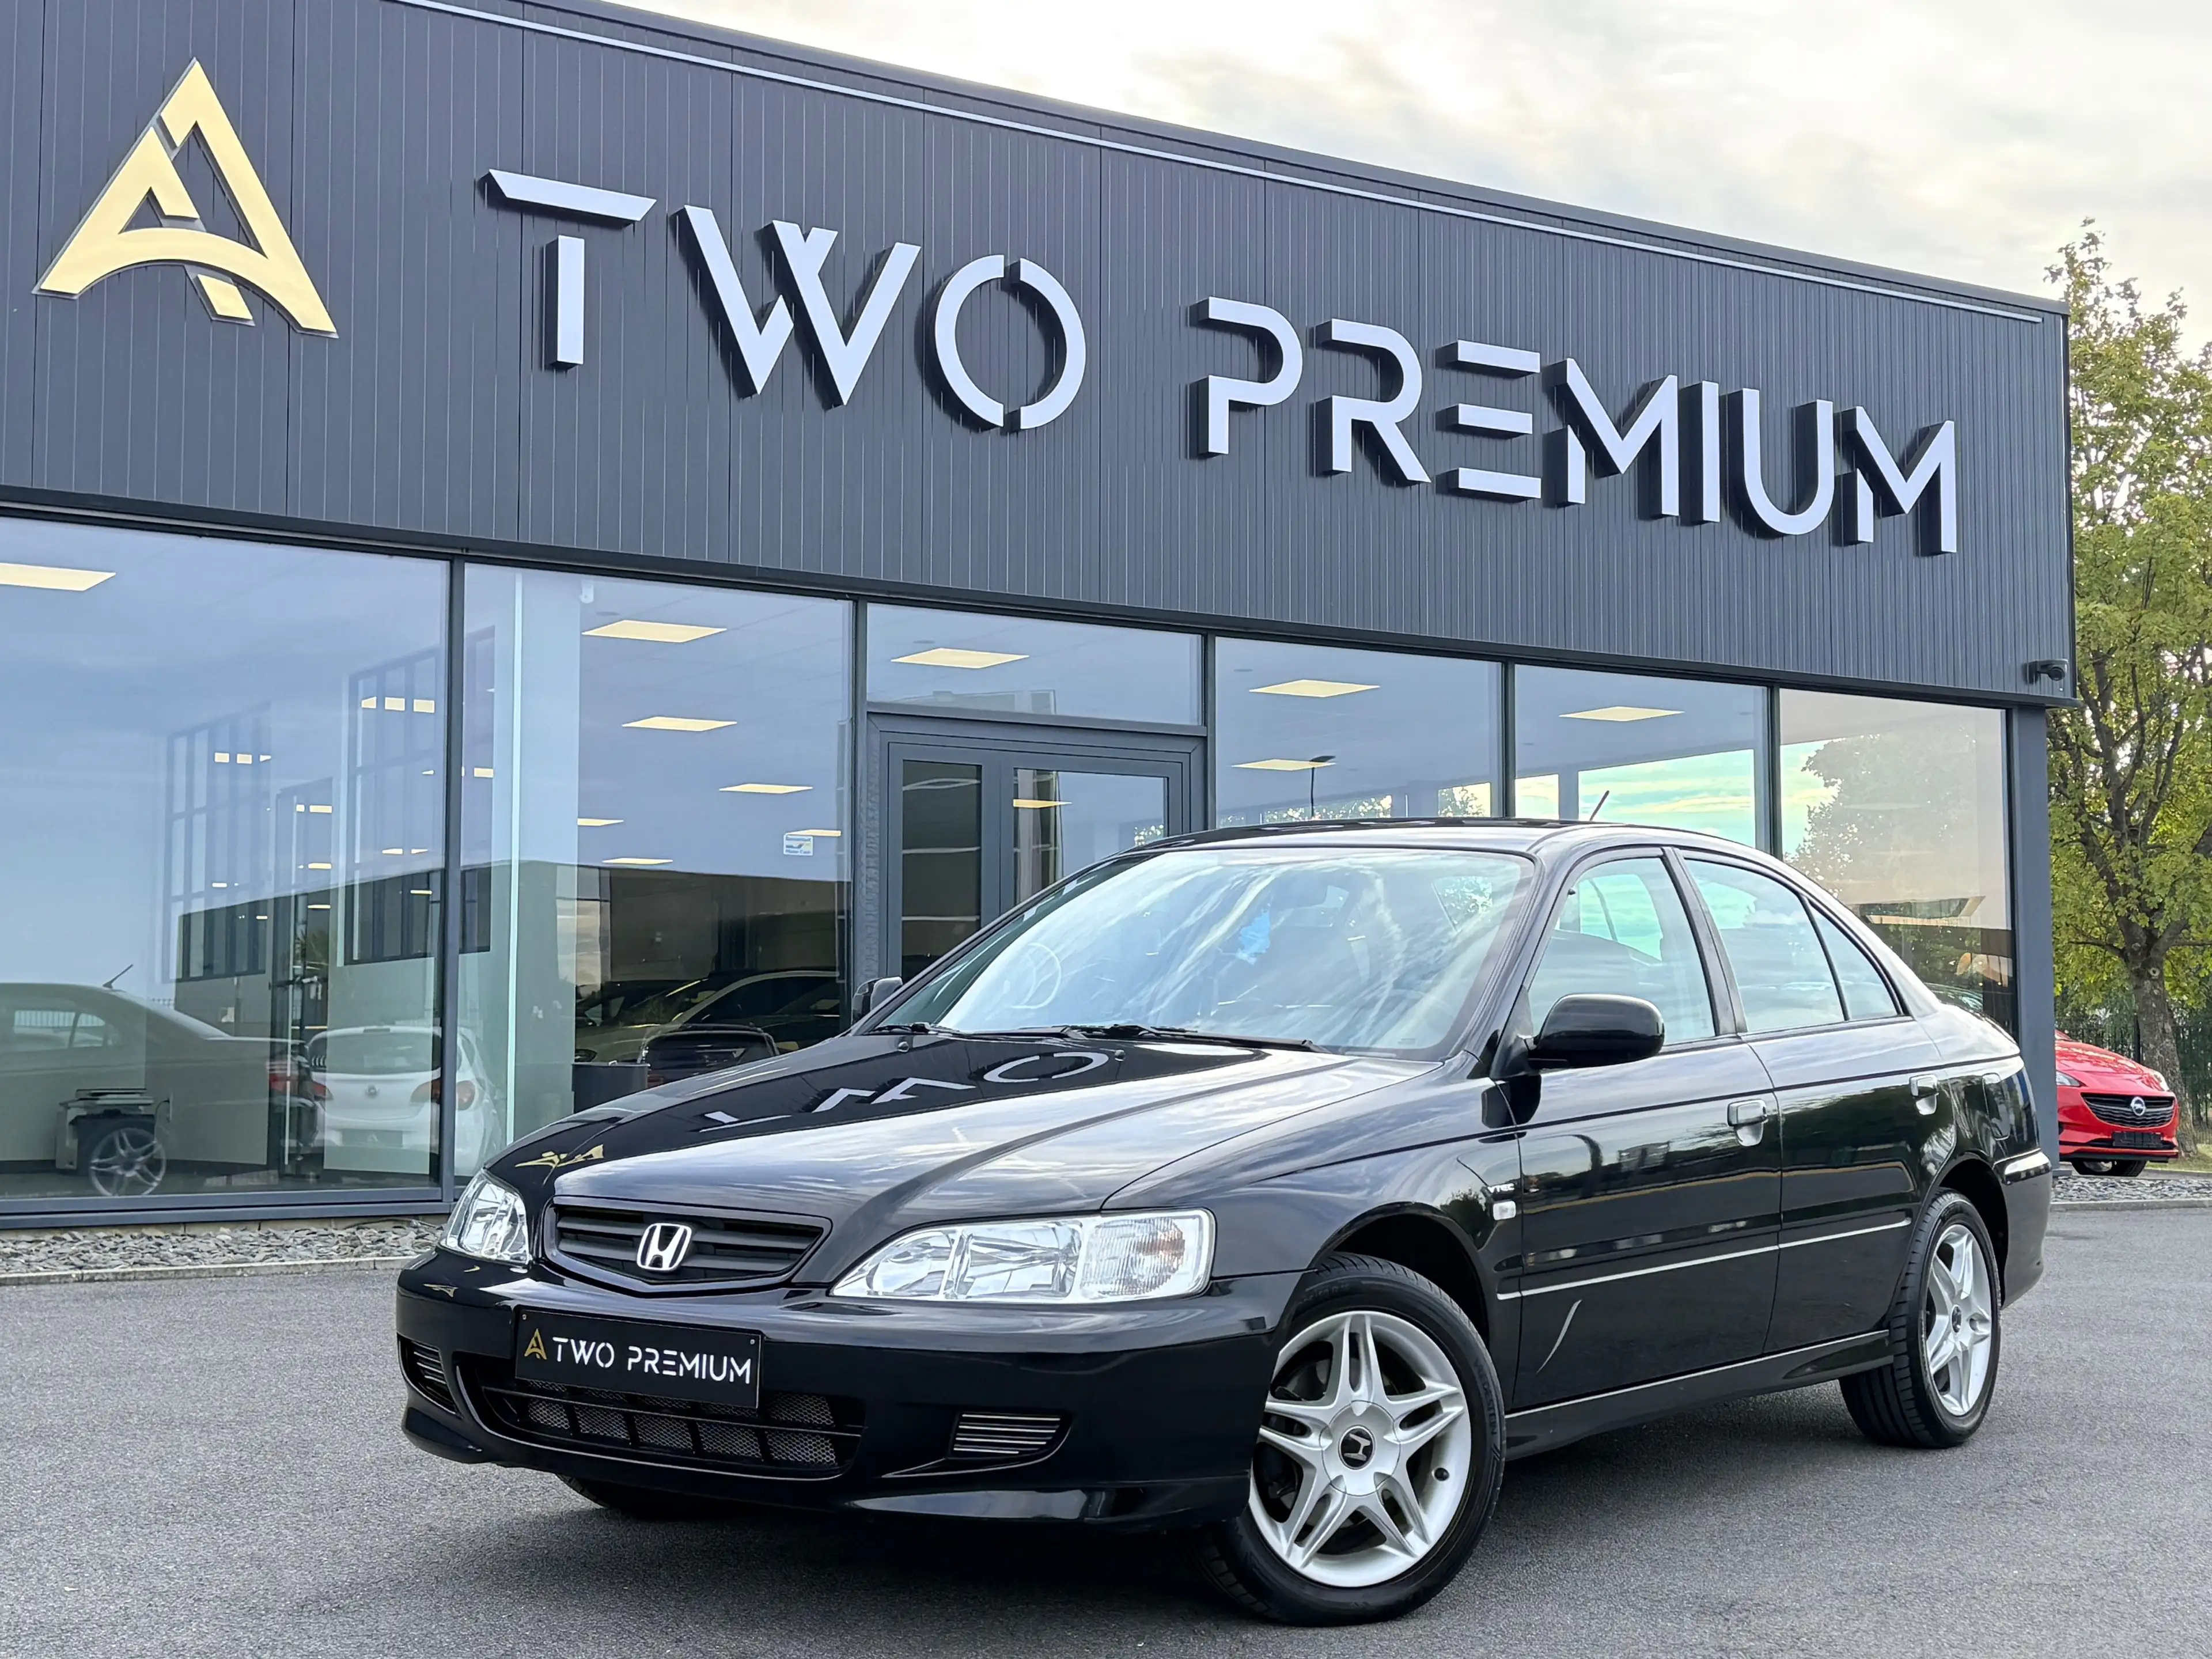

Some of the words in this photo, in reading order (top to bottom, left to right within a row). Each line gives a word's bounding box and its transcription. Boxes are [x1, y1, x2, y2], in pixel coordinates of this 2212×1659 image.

[480, 169, 1086, 431] TWO
[1196, 296, 1957, 555] PREMIUM
[552, 1336, 615, 1369] TWO
[627, 1345, 751, 1385] PREMIUM
